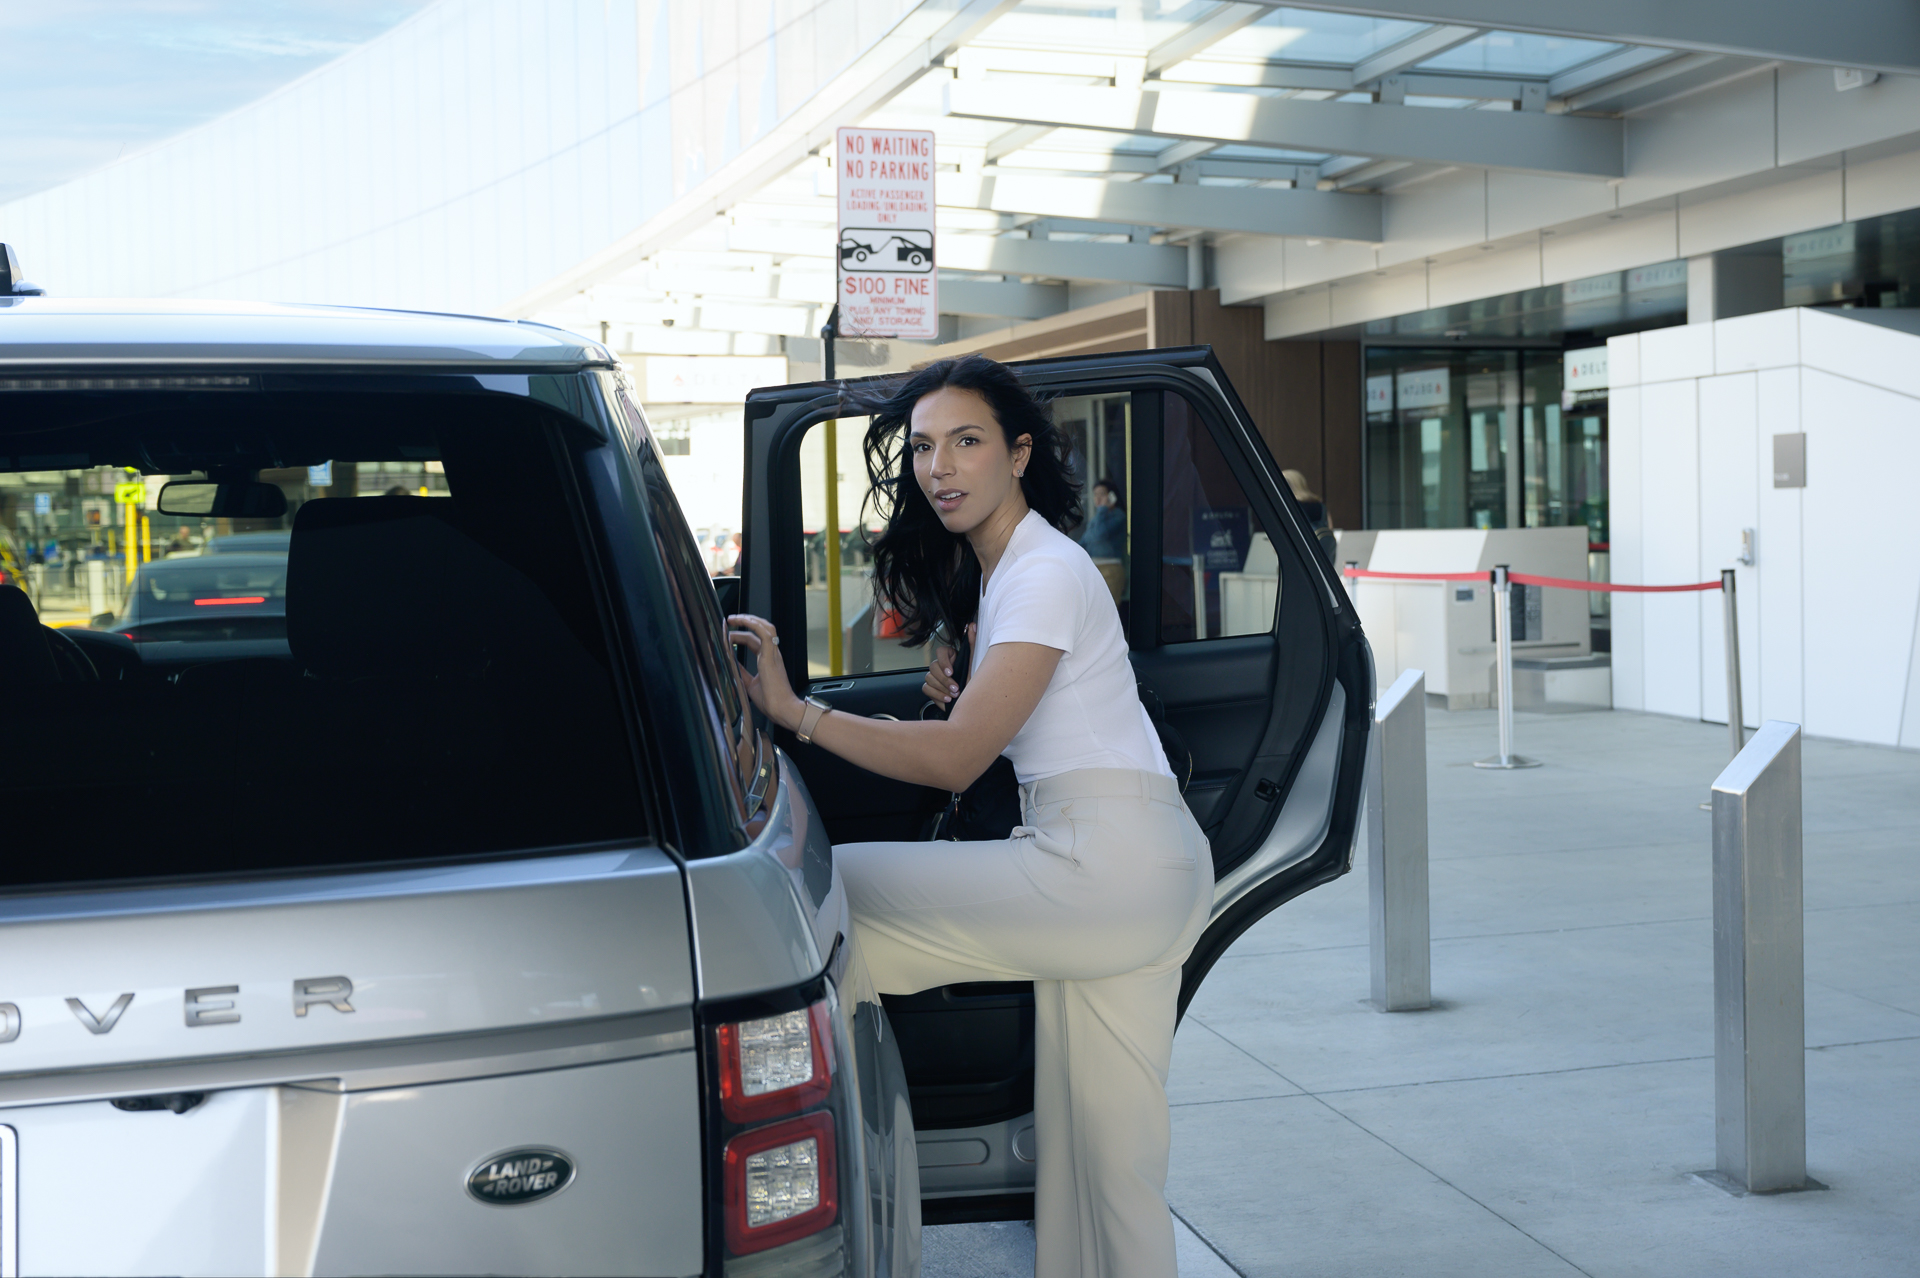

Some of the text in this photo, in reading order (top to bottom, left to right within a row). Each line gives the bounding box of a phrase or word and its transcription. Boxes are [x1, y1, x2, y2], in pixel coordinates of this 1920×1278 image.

[846, 135, 929, 157] NO WAITING
[846, 159, 929, 181] NO PARKING
[850, 189, 924, 201] ACTIVE PASSENGER
[877, 213, 897, 223] ONLY
[845, 276, 930, 295] $100 FINE
[870, 296, 906, 304] MINIMUM
[849, 306, 926, 315] PLUS ANY TOWING
[853, 317, 923, 326] AND STORAGE
[694, 373, 763, 386] DELTA
[488, 1158, 542, 1181] LAND
[494, 1171, 558, 1196] ROVER
